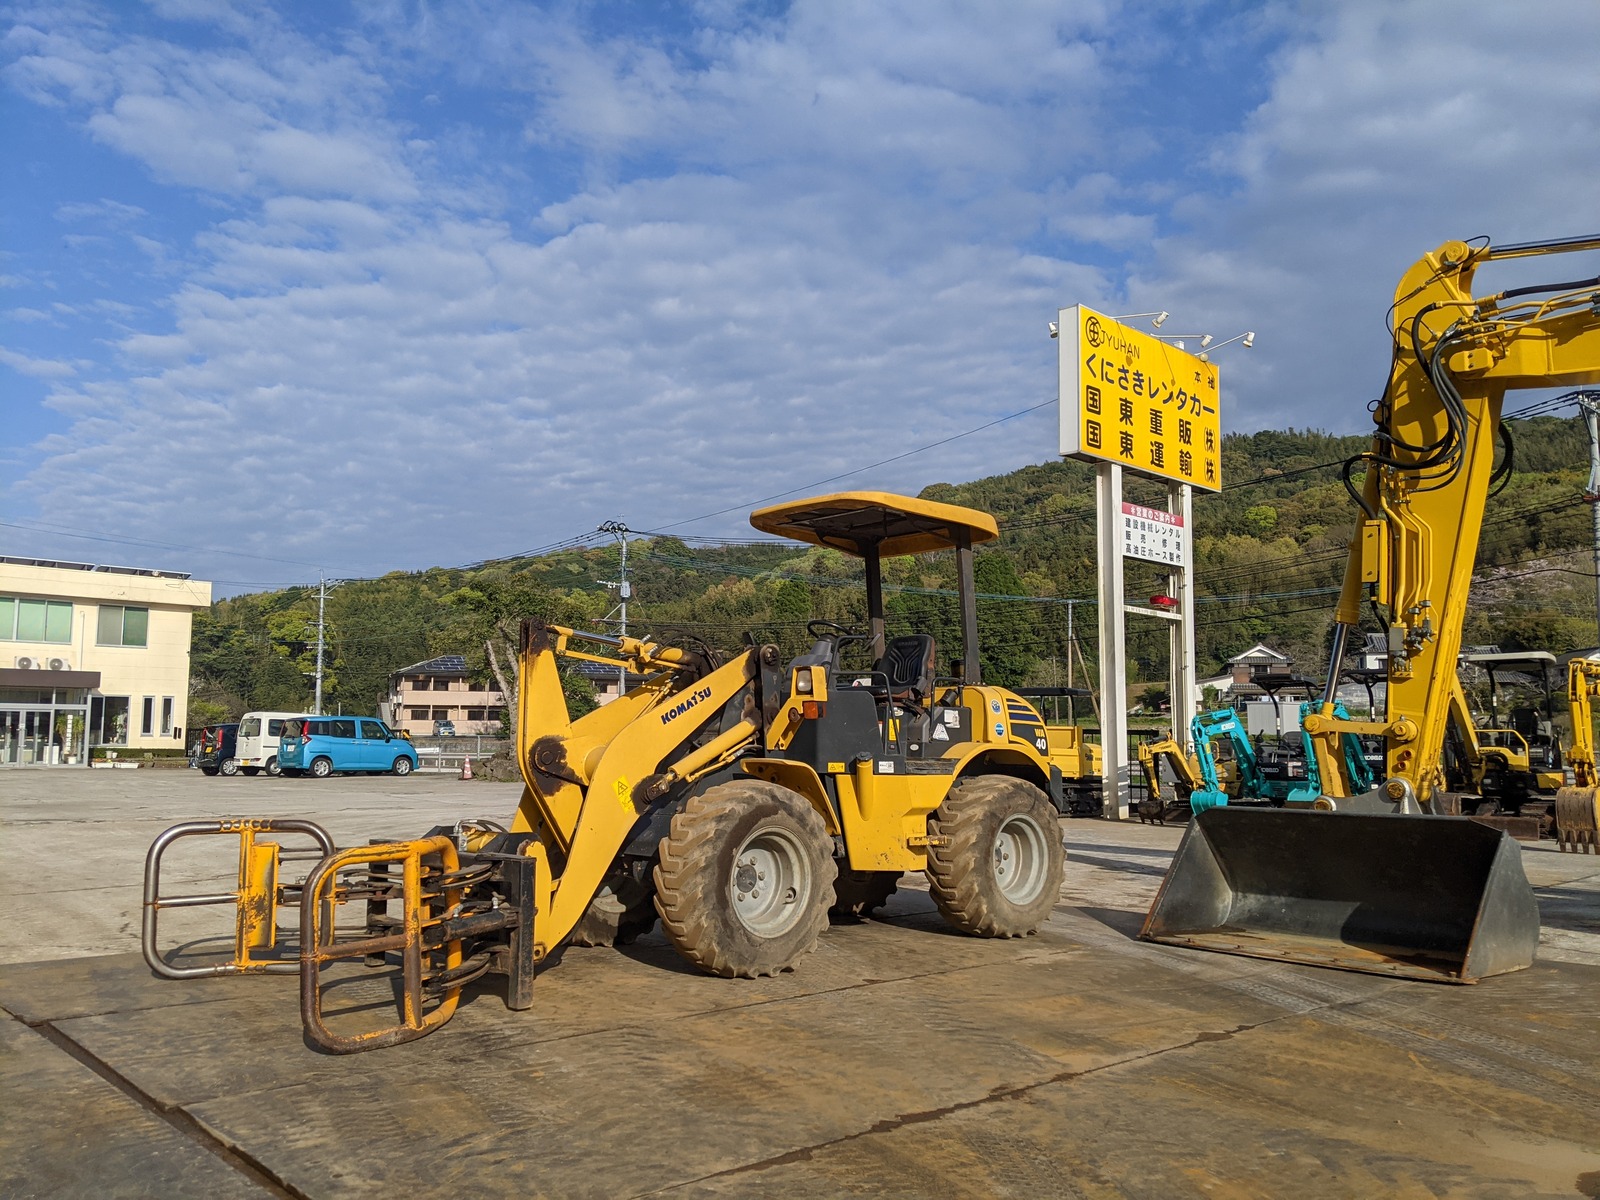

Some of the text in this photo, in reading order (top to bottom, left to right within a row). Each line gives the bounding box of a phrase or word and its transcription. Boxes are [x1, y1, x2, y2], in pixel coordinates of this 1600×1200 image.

[1100, 329, 1140, 359] JYUHAN
[1085, 353, 1215, 417] くにさきレンタカー
[1194, 371, 1215, 390] 本社
[661, 686, 712, 725] KOMATSU
[1034, 728, 1045, 737] WA
[1035, 738, 1047, 749] 40
